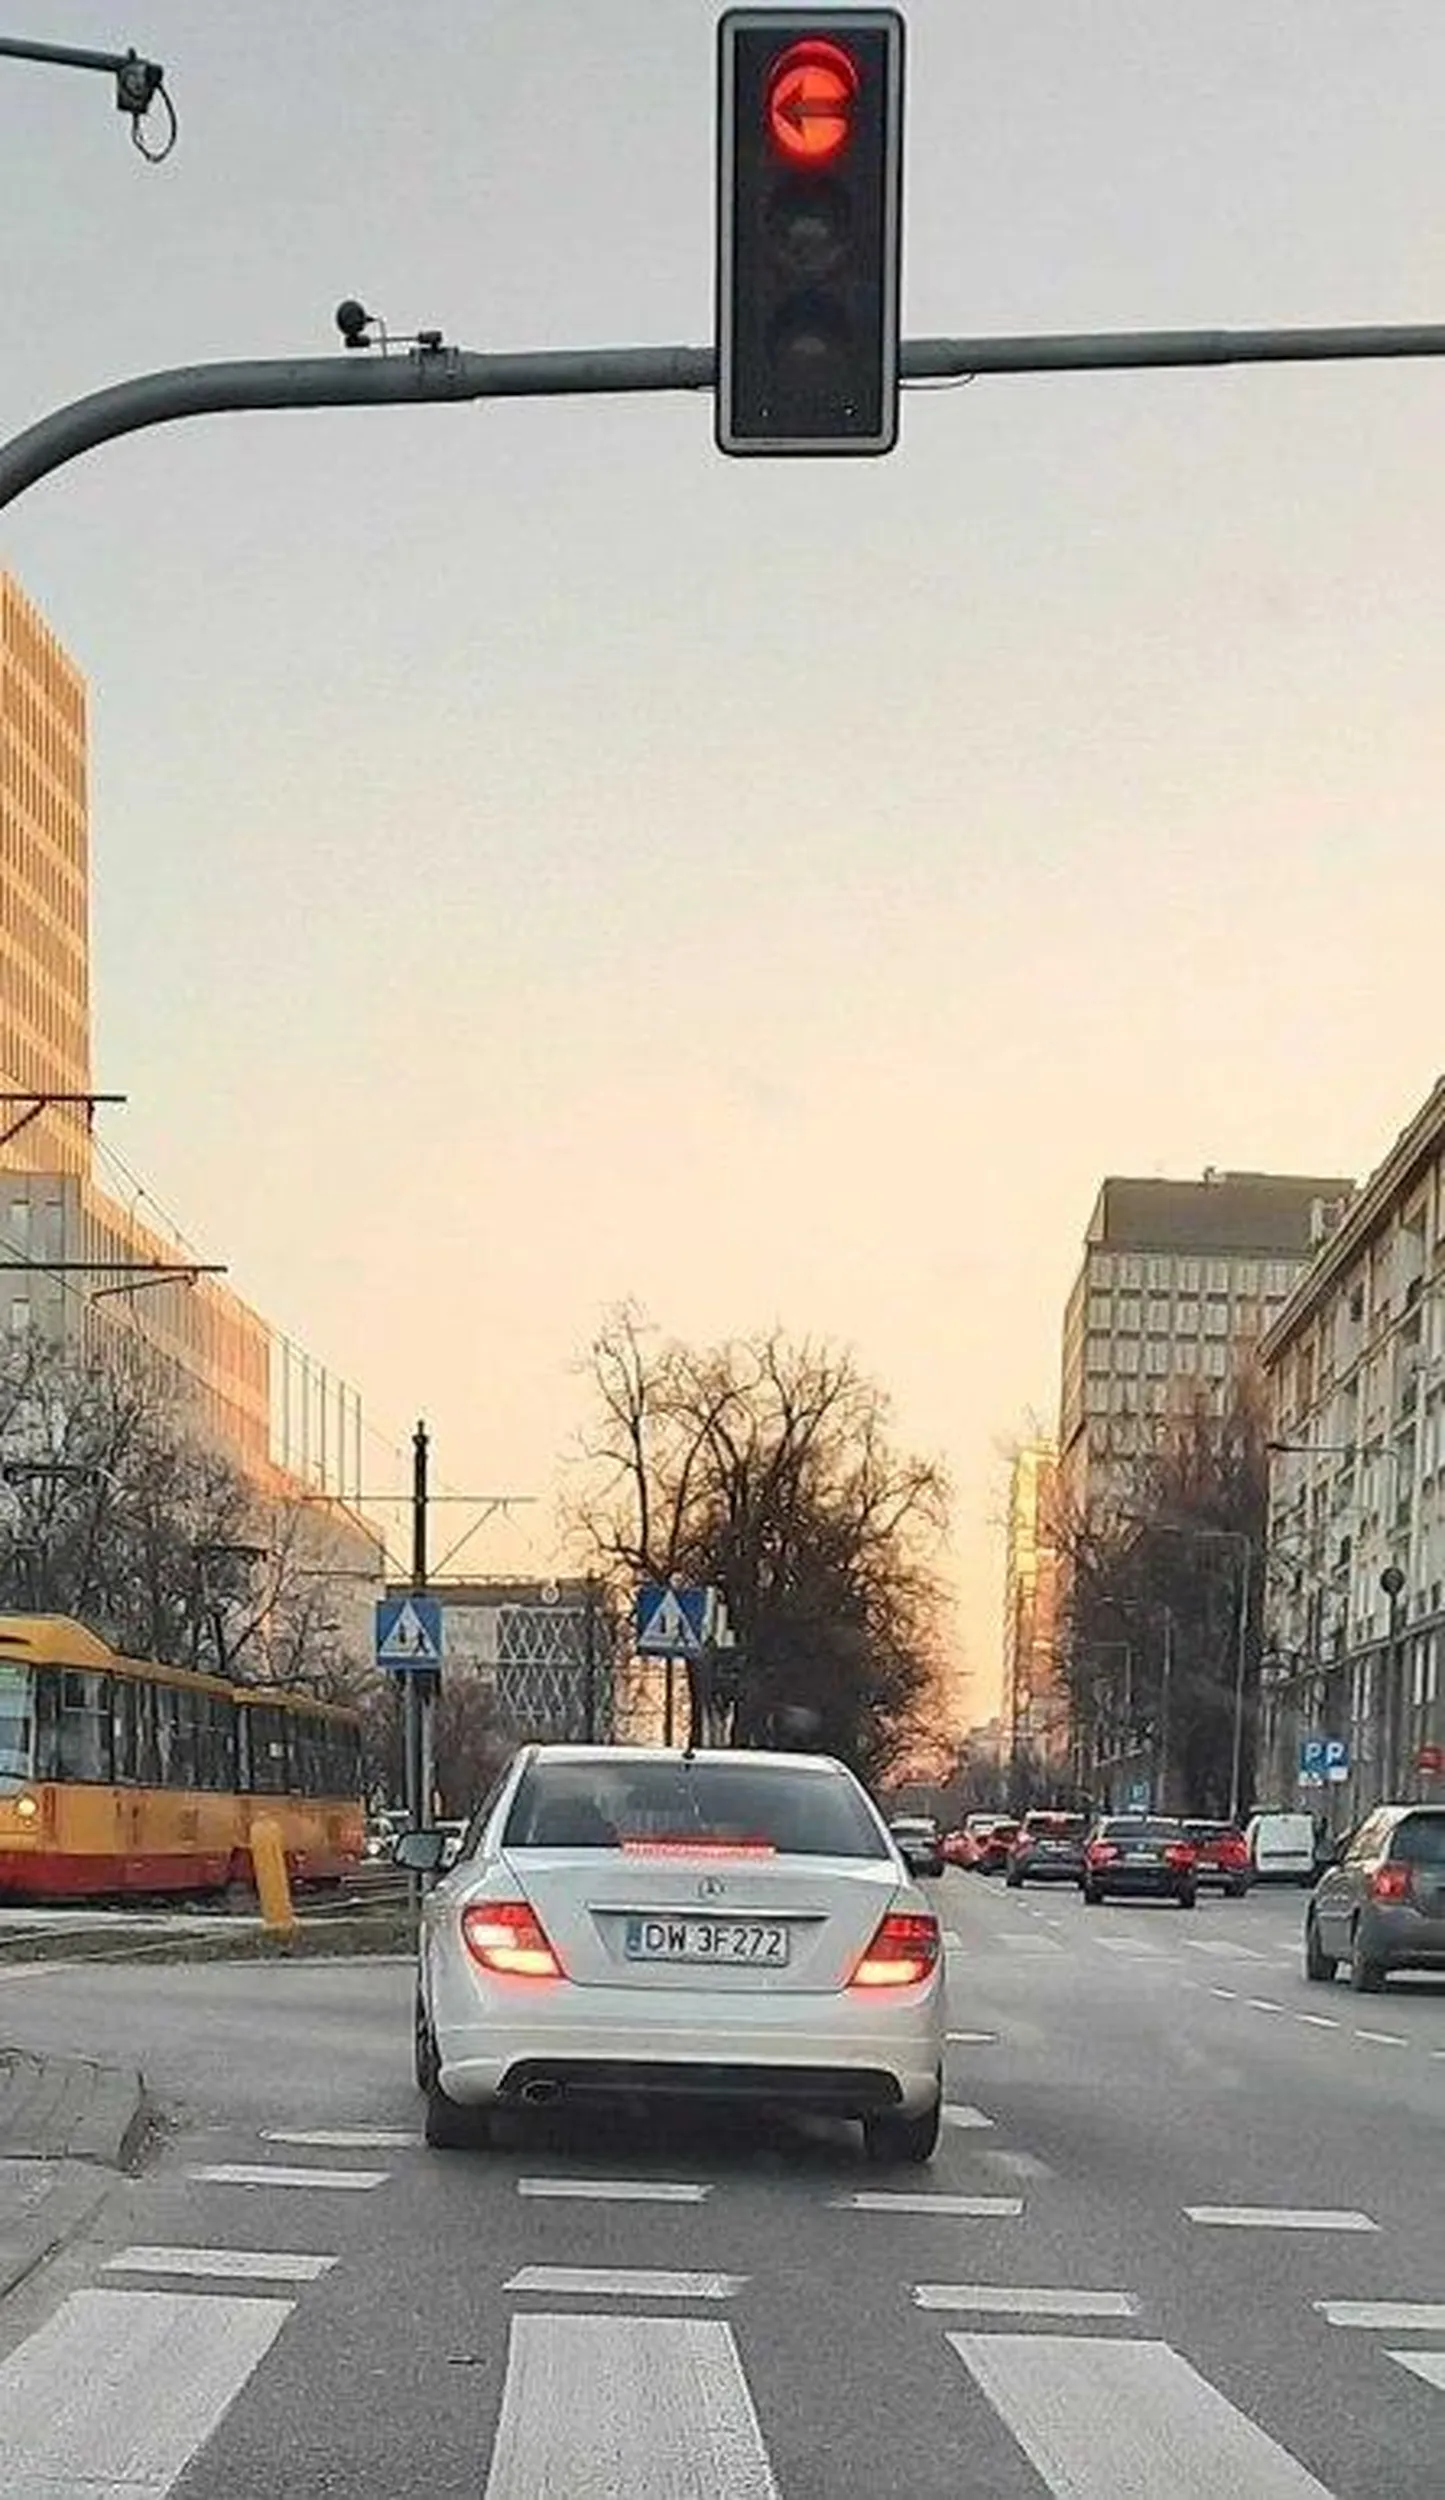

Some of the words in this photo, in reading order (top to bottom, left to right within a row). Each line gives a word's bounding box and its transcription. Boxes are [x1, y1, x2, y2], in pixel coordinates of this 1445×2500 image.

[1305, 1742, 1322, 1763] P
[1327, 1741, 1344, 1763] P
[646, 1924, 686, 1952] DW
[698, 1926, 781, 1957] 3F272
